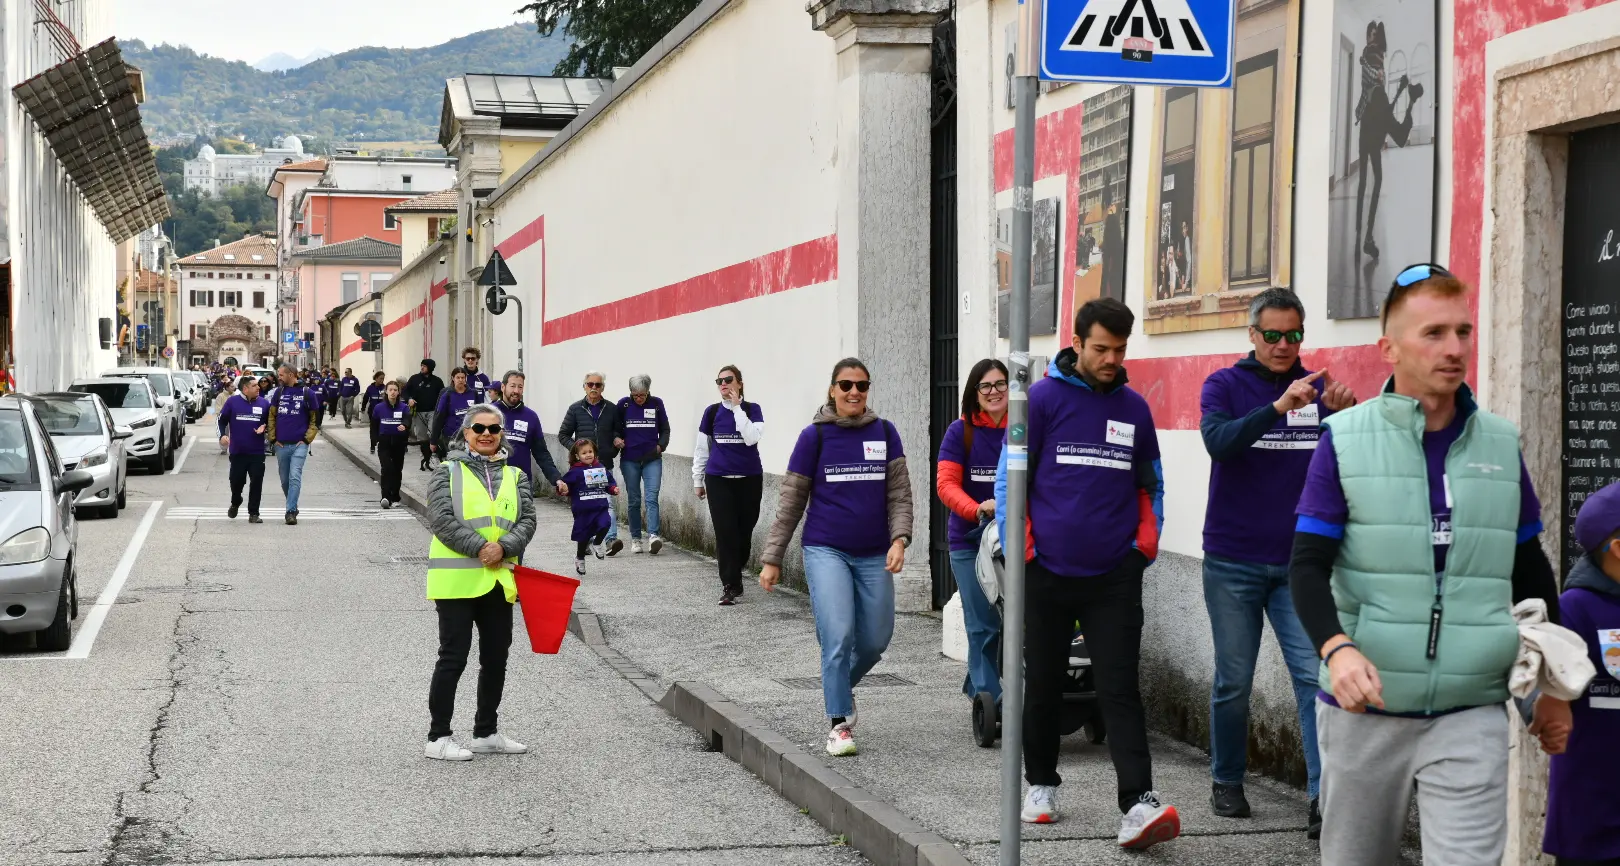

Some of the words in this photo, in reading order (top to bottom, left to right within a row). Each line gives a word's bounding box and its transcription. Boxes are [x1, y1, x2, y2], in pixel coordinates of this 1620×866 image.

[1566, 302, 1586, 319] Come
[1588, 304, 1611, 316] vivono
[1589, 321, 1616, 336] durante
[286, 333, 292, 342] P
[1567, 343, 1590, 357] Questo
[1592, 342, 1618, 361] progetto
[1567, 380, 1589, 400] Grazie
[1116, 430, 1134, 439] Asuit
[1056, 445, 1070, 453] Corri
[1080, 458, 1113, 467] TRENTO
[1589, 683, 1609, 693] Corri
